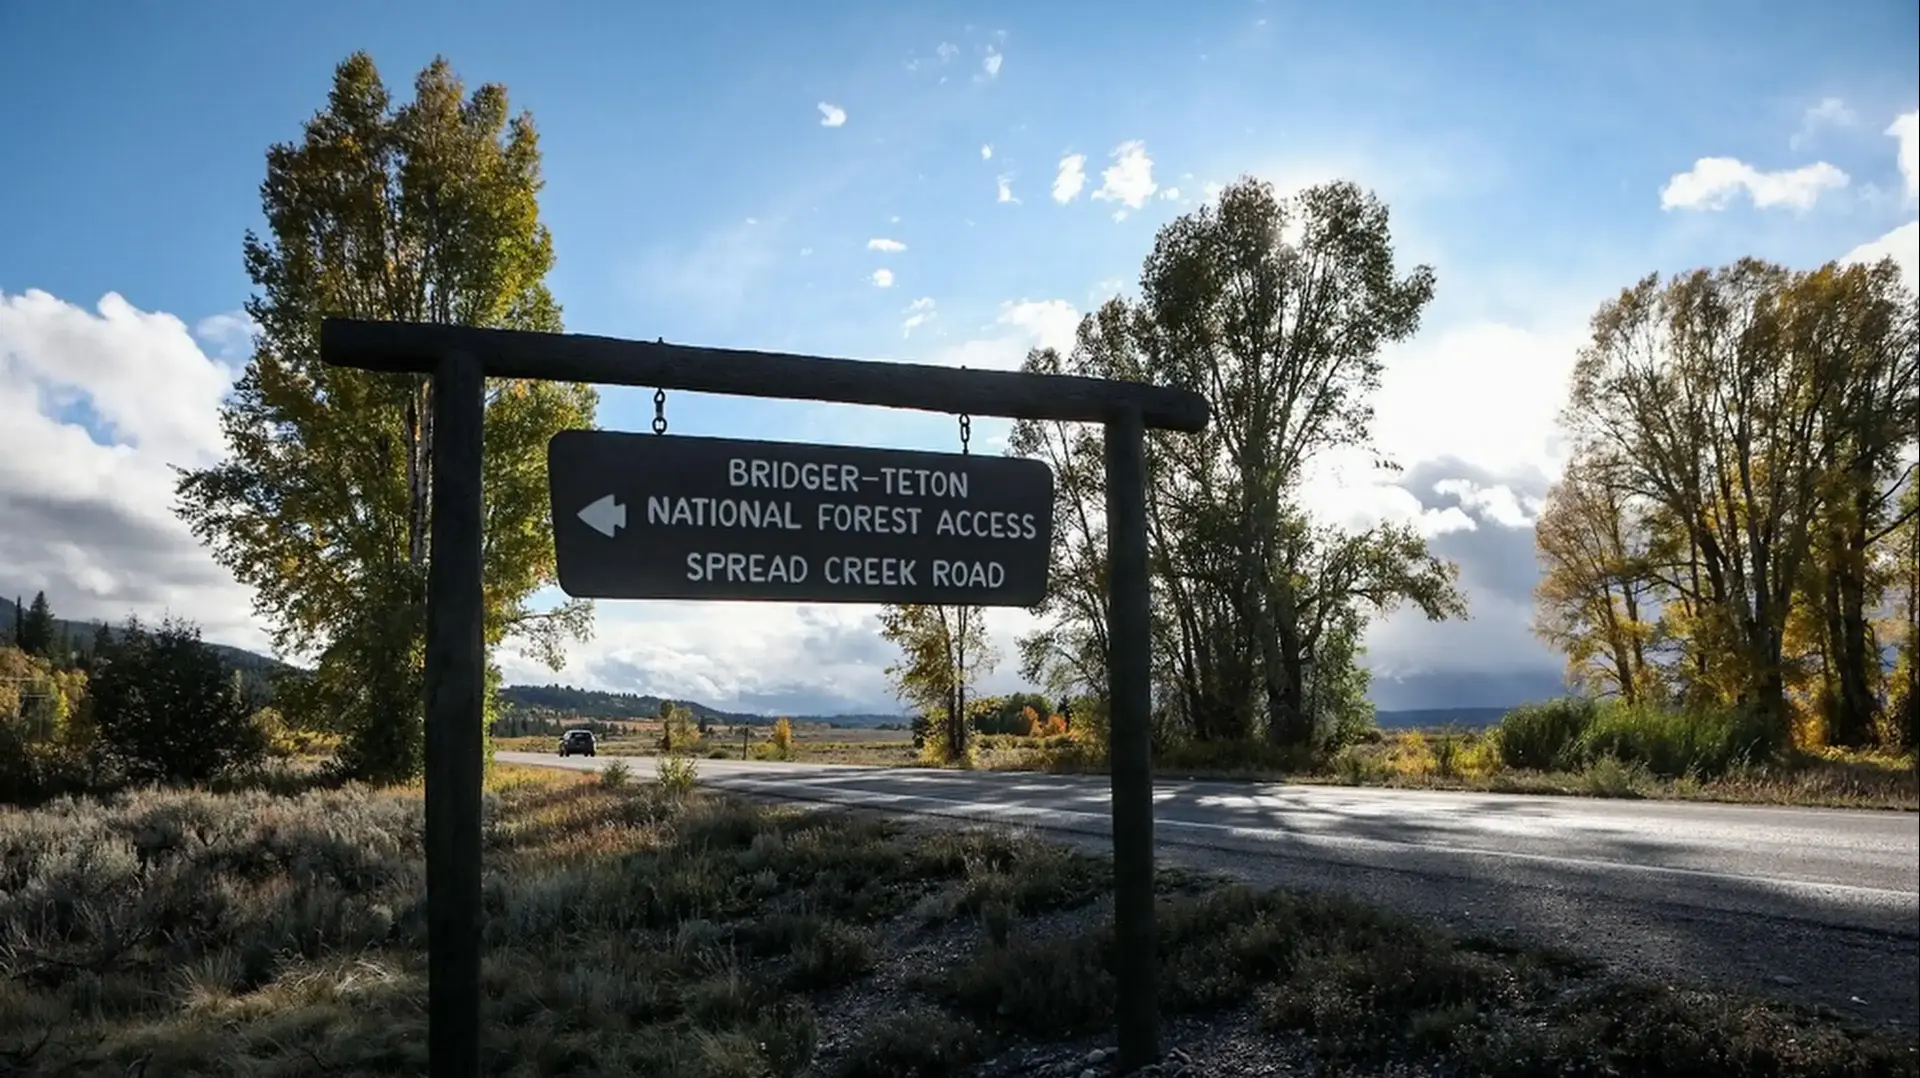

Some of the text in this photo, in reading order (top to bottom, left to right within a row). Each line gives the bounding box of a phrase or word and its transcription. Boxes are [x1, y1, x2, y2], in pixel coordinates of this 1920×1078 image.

[728, 458, 968, 498] BRIDGER-TETON
[647, 496, 1037, 539] NATIONAL FOREST ACCESS
[686, 552, 1005, 588] SPREAD CREEK ROAD
